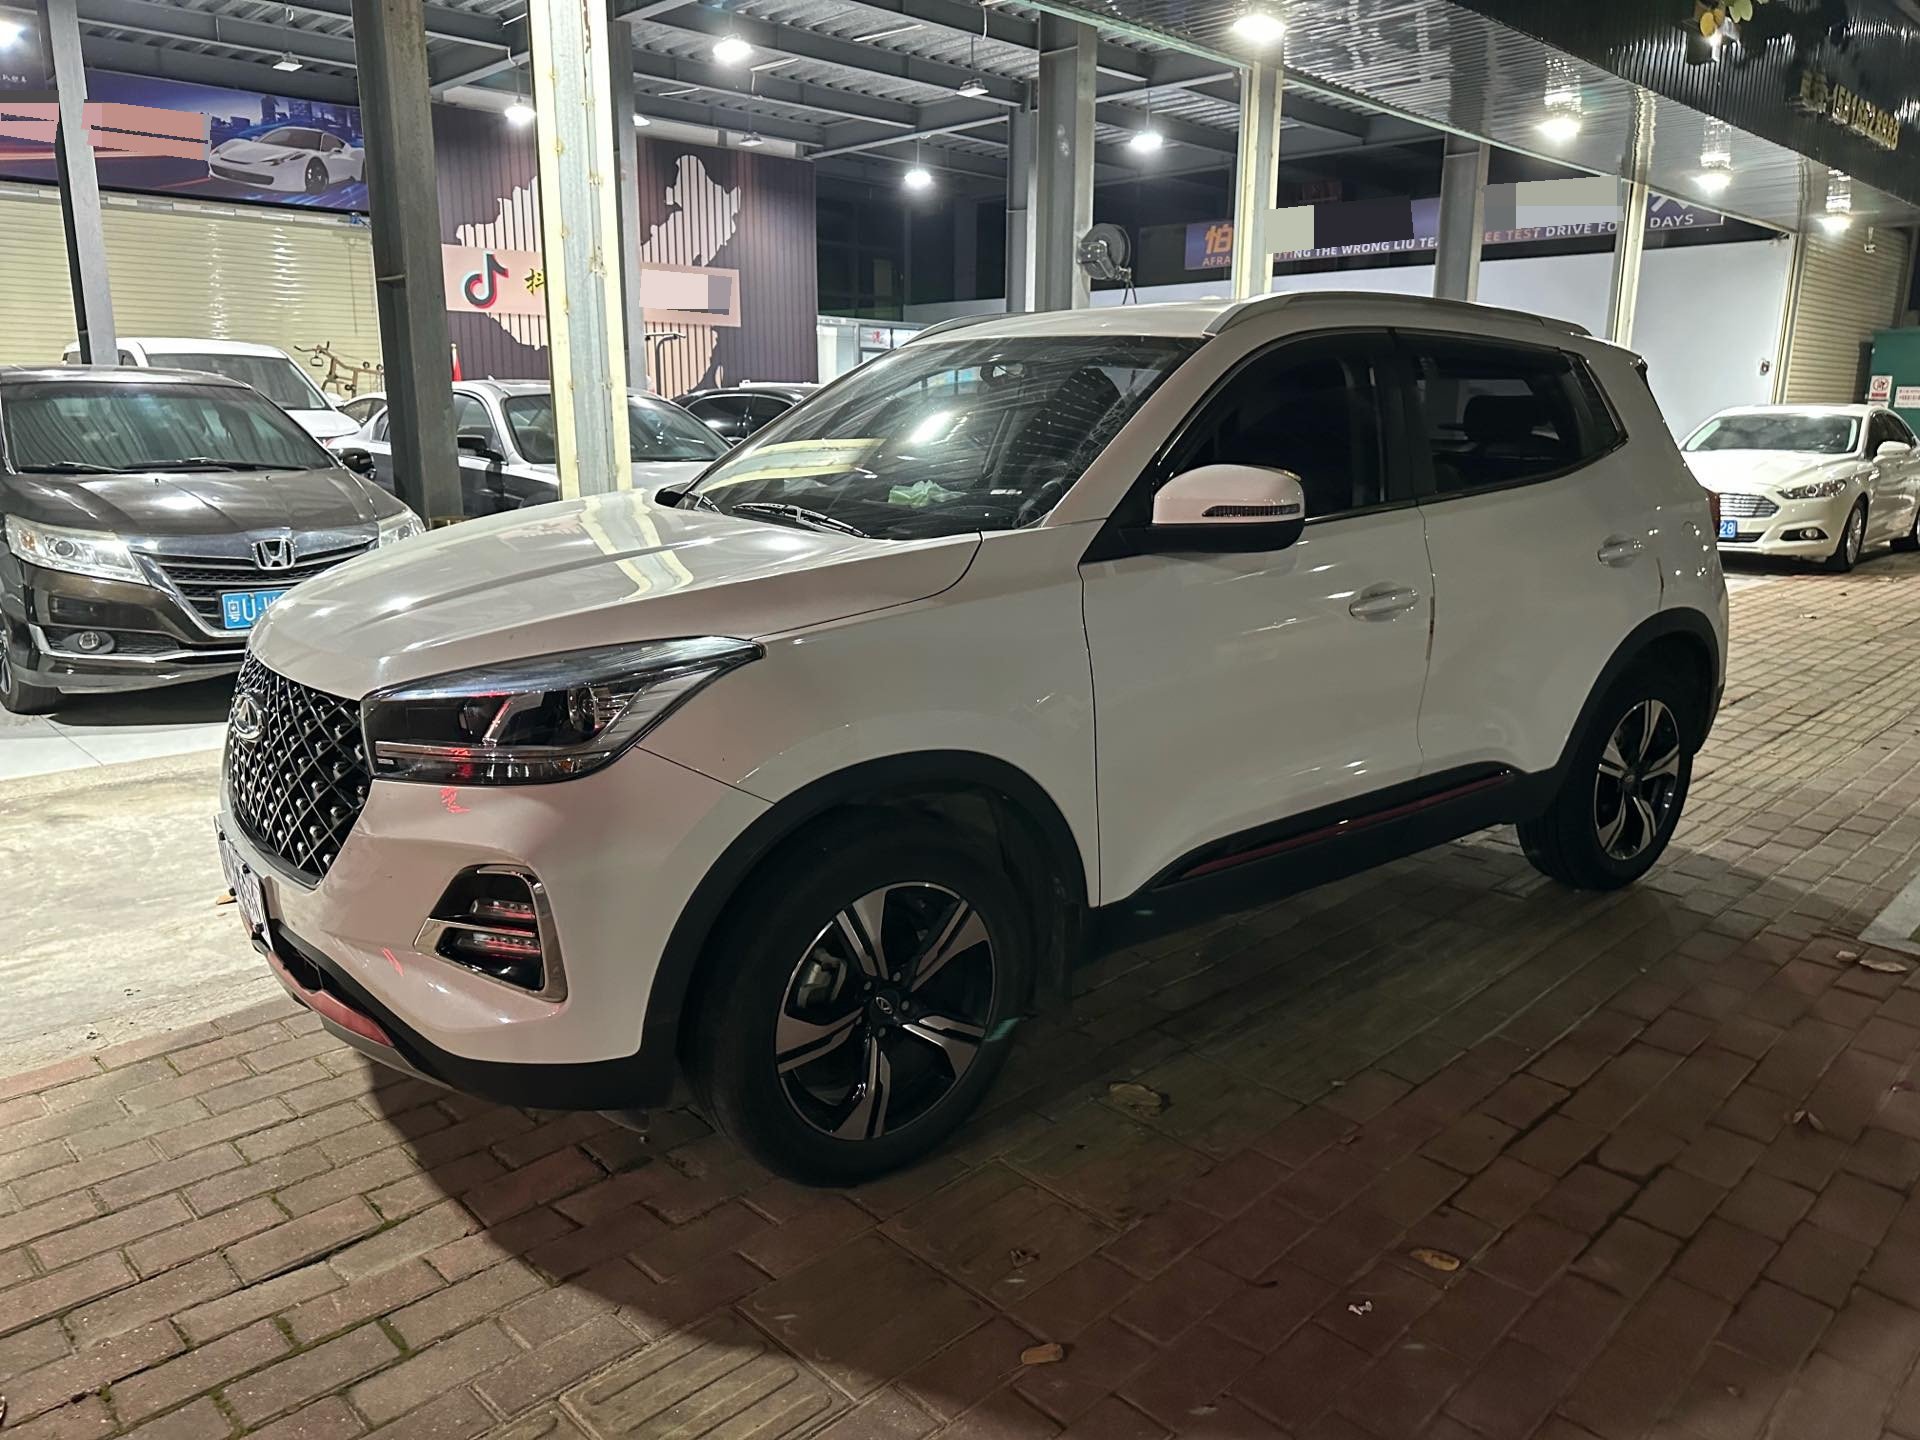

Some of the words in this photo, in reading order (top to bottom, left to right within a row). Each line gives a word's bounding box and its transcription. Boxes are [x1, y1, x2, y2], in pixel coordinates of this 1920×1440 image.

[1202, 255, 1231, 267] AFRA
[1273, 248, 1312, 260] UYING
[1315, 246, 1337, 257] THE
[1341, 241, 1390, 255] WRONG
[1393, 238, 1415, 250] LIU
[1419, 236, 1438, 248] TE
[1484, 231, 1501, 242] EE
[1506, 228, 1540, 240] TEST
[1545, 223, 1592, 237] DRIVE
[1597, 221, 1617, 234] FO
[1649, 213, 1694, 228] DAYS
